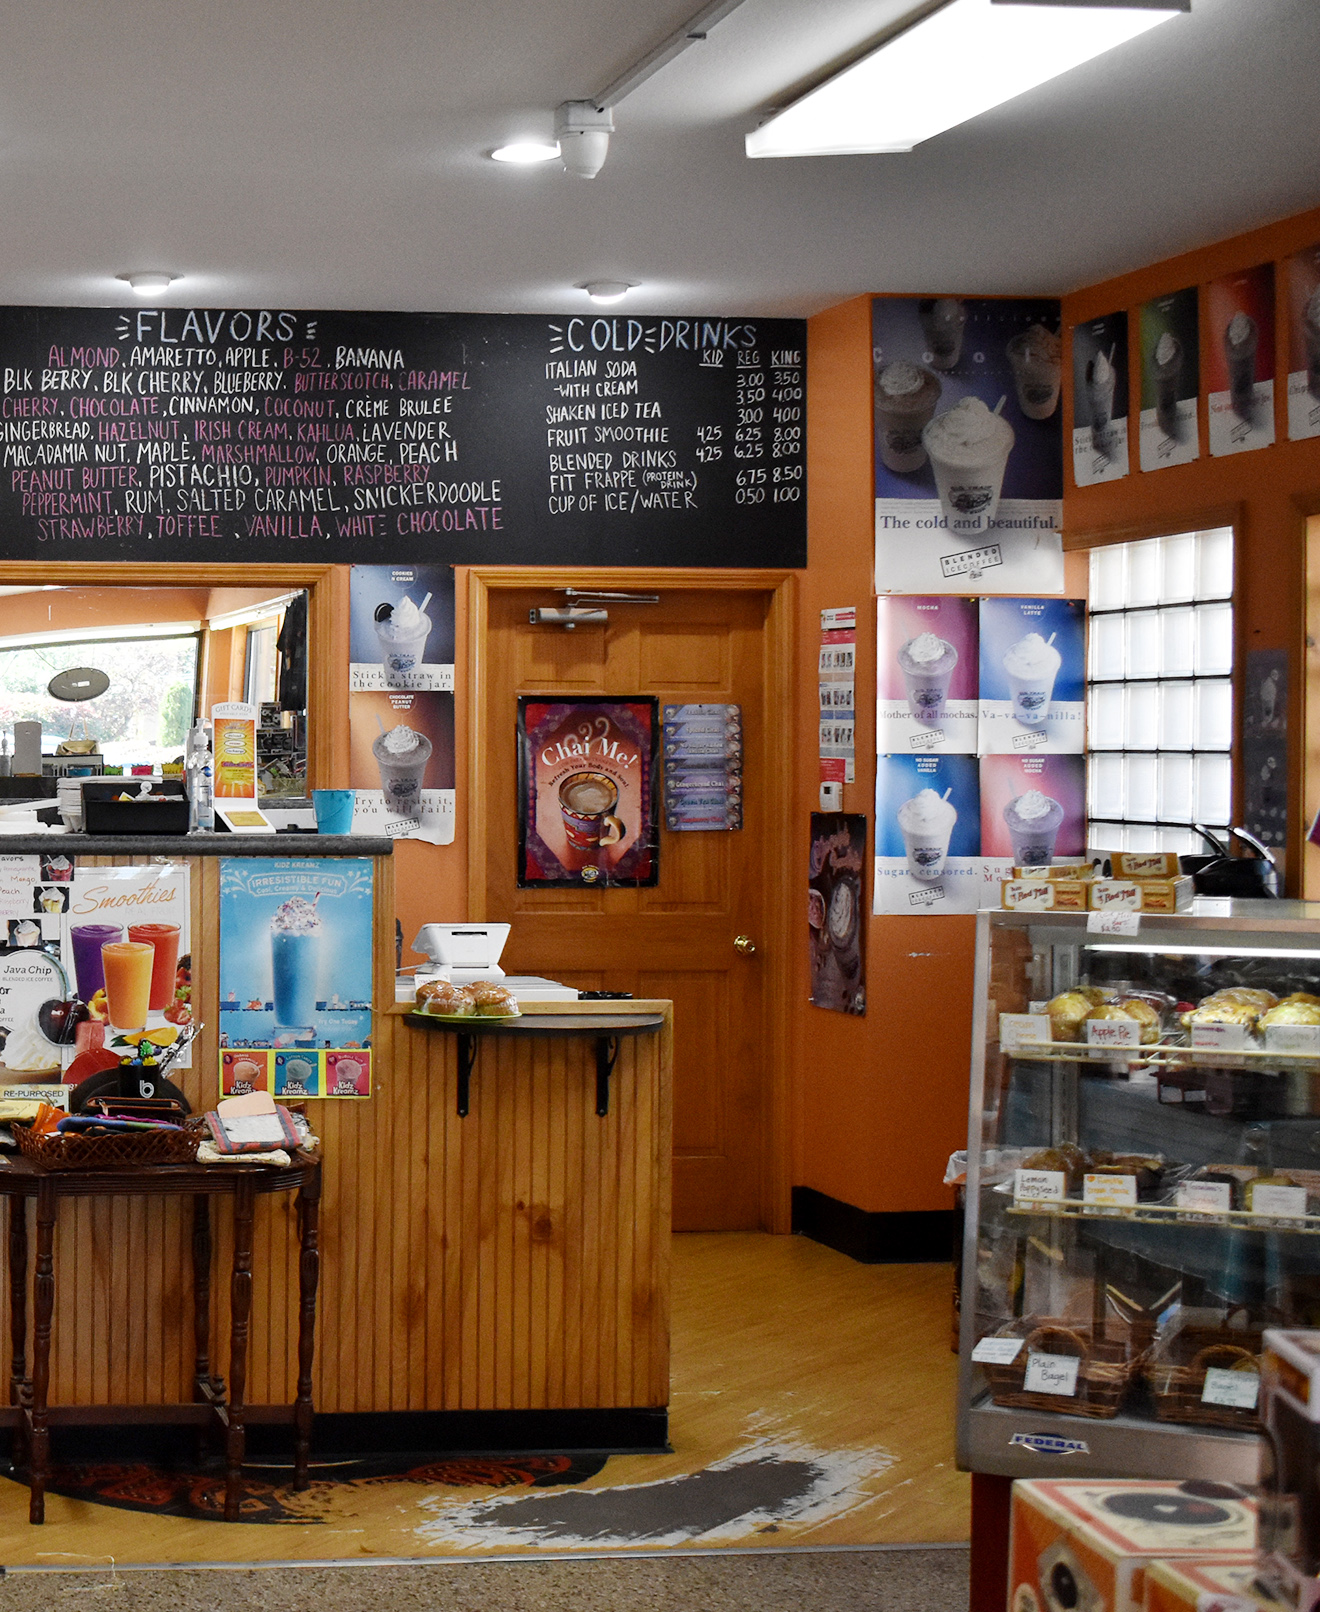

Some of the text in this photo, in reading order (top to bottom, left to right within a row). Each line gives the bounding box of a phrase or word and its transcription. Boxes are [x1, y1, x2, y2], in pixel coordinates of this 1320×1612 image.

[137, 310, 297, 343] FLAVORS
[567, 318, 757, 352] COLD DRINKS
[702, 349, 801, 365] KID REG KING
[545, 360, 800, 387] ITALIAN SODA 3.00 3.50
[546, 402, 596, 425] SHAKEN
[602, 402, 629, 420] ICED
[635, 402, 662, 419] TEA
[737, 407, 763, 426] 3.00
[547, 427, 588, 447] FRUIT
[594, 426, 669, 443] SMOOTHIE
[735, 427, 762, 442] 6.25
[773, 426, 801, 442] 8.00
[549, 441, 800, 472] BLENDED DRINKS 4.25 6.25 8.00
[12, 468, 74, 493] PEANUT
[150, 464, 259, 487] PISTACHIO,
[344, 464, 430, 486] RASPBERRY
[550, 474, 576, 493] FIT
[584, 470, 636, 489] FRAPPE
[735, 468, 767, 486] 6.75
[772, 465, 802, 482] 8.50
[548, 486, 801, 515] CUP OF ICE/WATER 0.50 1.00
[880, 516, 1058, 529] The cold and beautiful.
[353, 671, 384, 679] Stick
[401, 671, 434, 679] straw
[440, 671, 451, 679] in
[353, 680, 451, 689] the cookie jar.
[215, 704, 252, 713] GIFT CARDS
[542, 736, 638, 769] Chai Me!
[354, 805, 452, 816] you will fail.
[919, 866, 978, 876] censored.
[251, 875, 341, 888] IRRESISTIBLE FUN
[72, 879, 177, 915] Smoothies
[4, 965, 52, 975] Java Chip
[1091, 1026, 1131, 1039] Apple Pie
[4, 1089, 64, 1098] RE-PURPOSED
[1032, 1358, 1056, 1369] Plain
[1041, 1369, 1068, 1382] Bagel
[1014, 1435, 1086, 1450] FEDERAL
